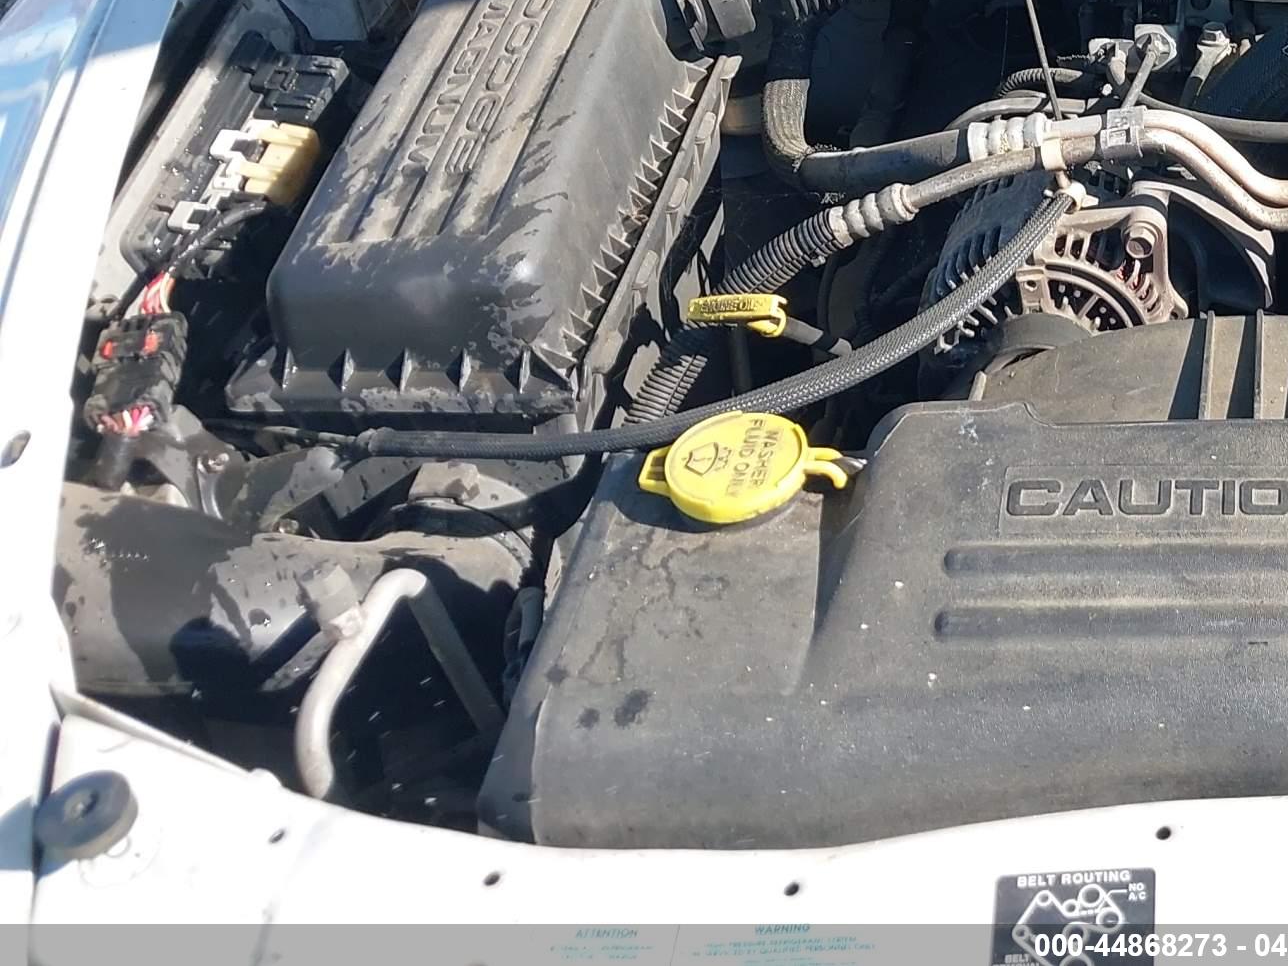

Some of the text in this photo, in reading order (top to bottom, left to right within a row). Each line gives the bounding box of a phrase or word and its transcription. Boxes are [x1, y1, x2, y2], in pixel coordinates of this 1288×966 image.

[739, 418, 766, 459] FLUID
[749, 425, 780, 489] WASHER
[1016, 869, 1131, 888] BELT ROUTING
[1128, 882, 1145, 892] NO
[1128, 891, 1146, 901] A/C
[575, 928, 638, 939] ATTENTION
[754, 923, 811, 935] WARNING
